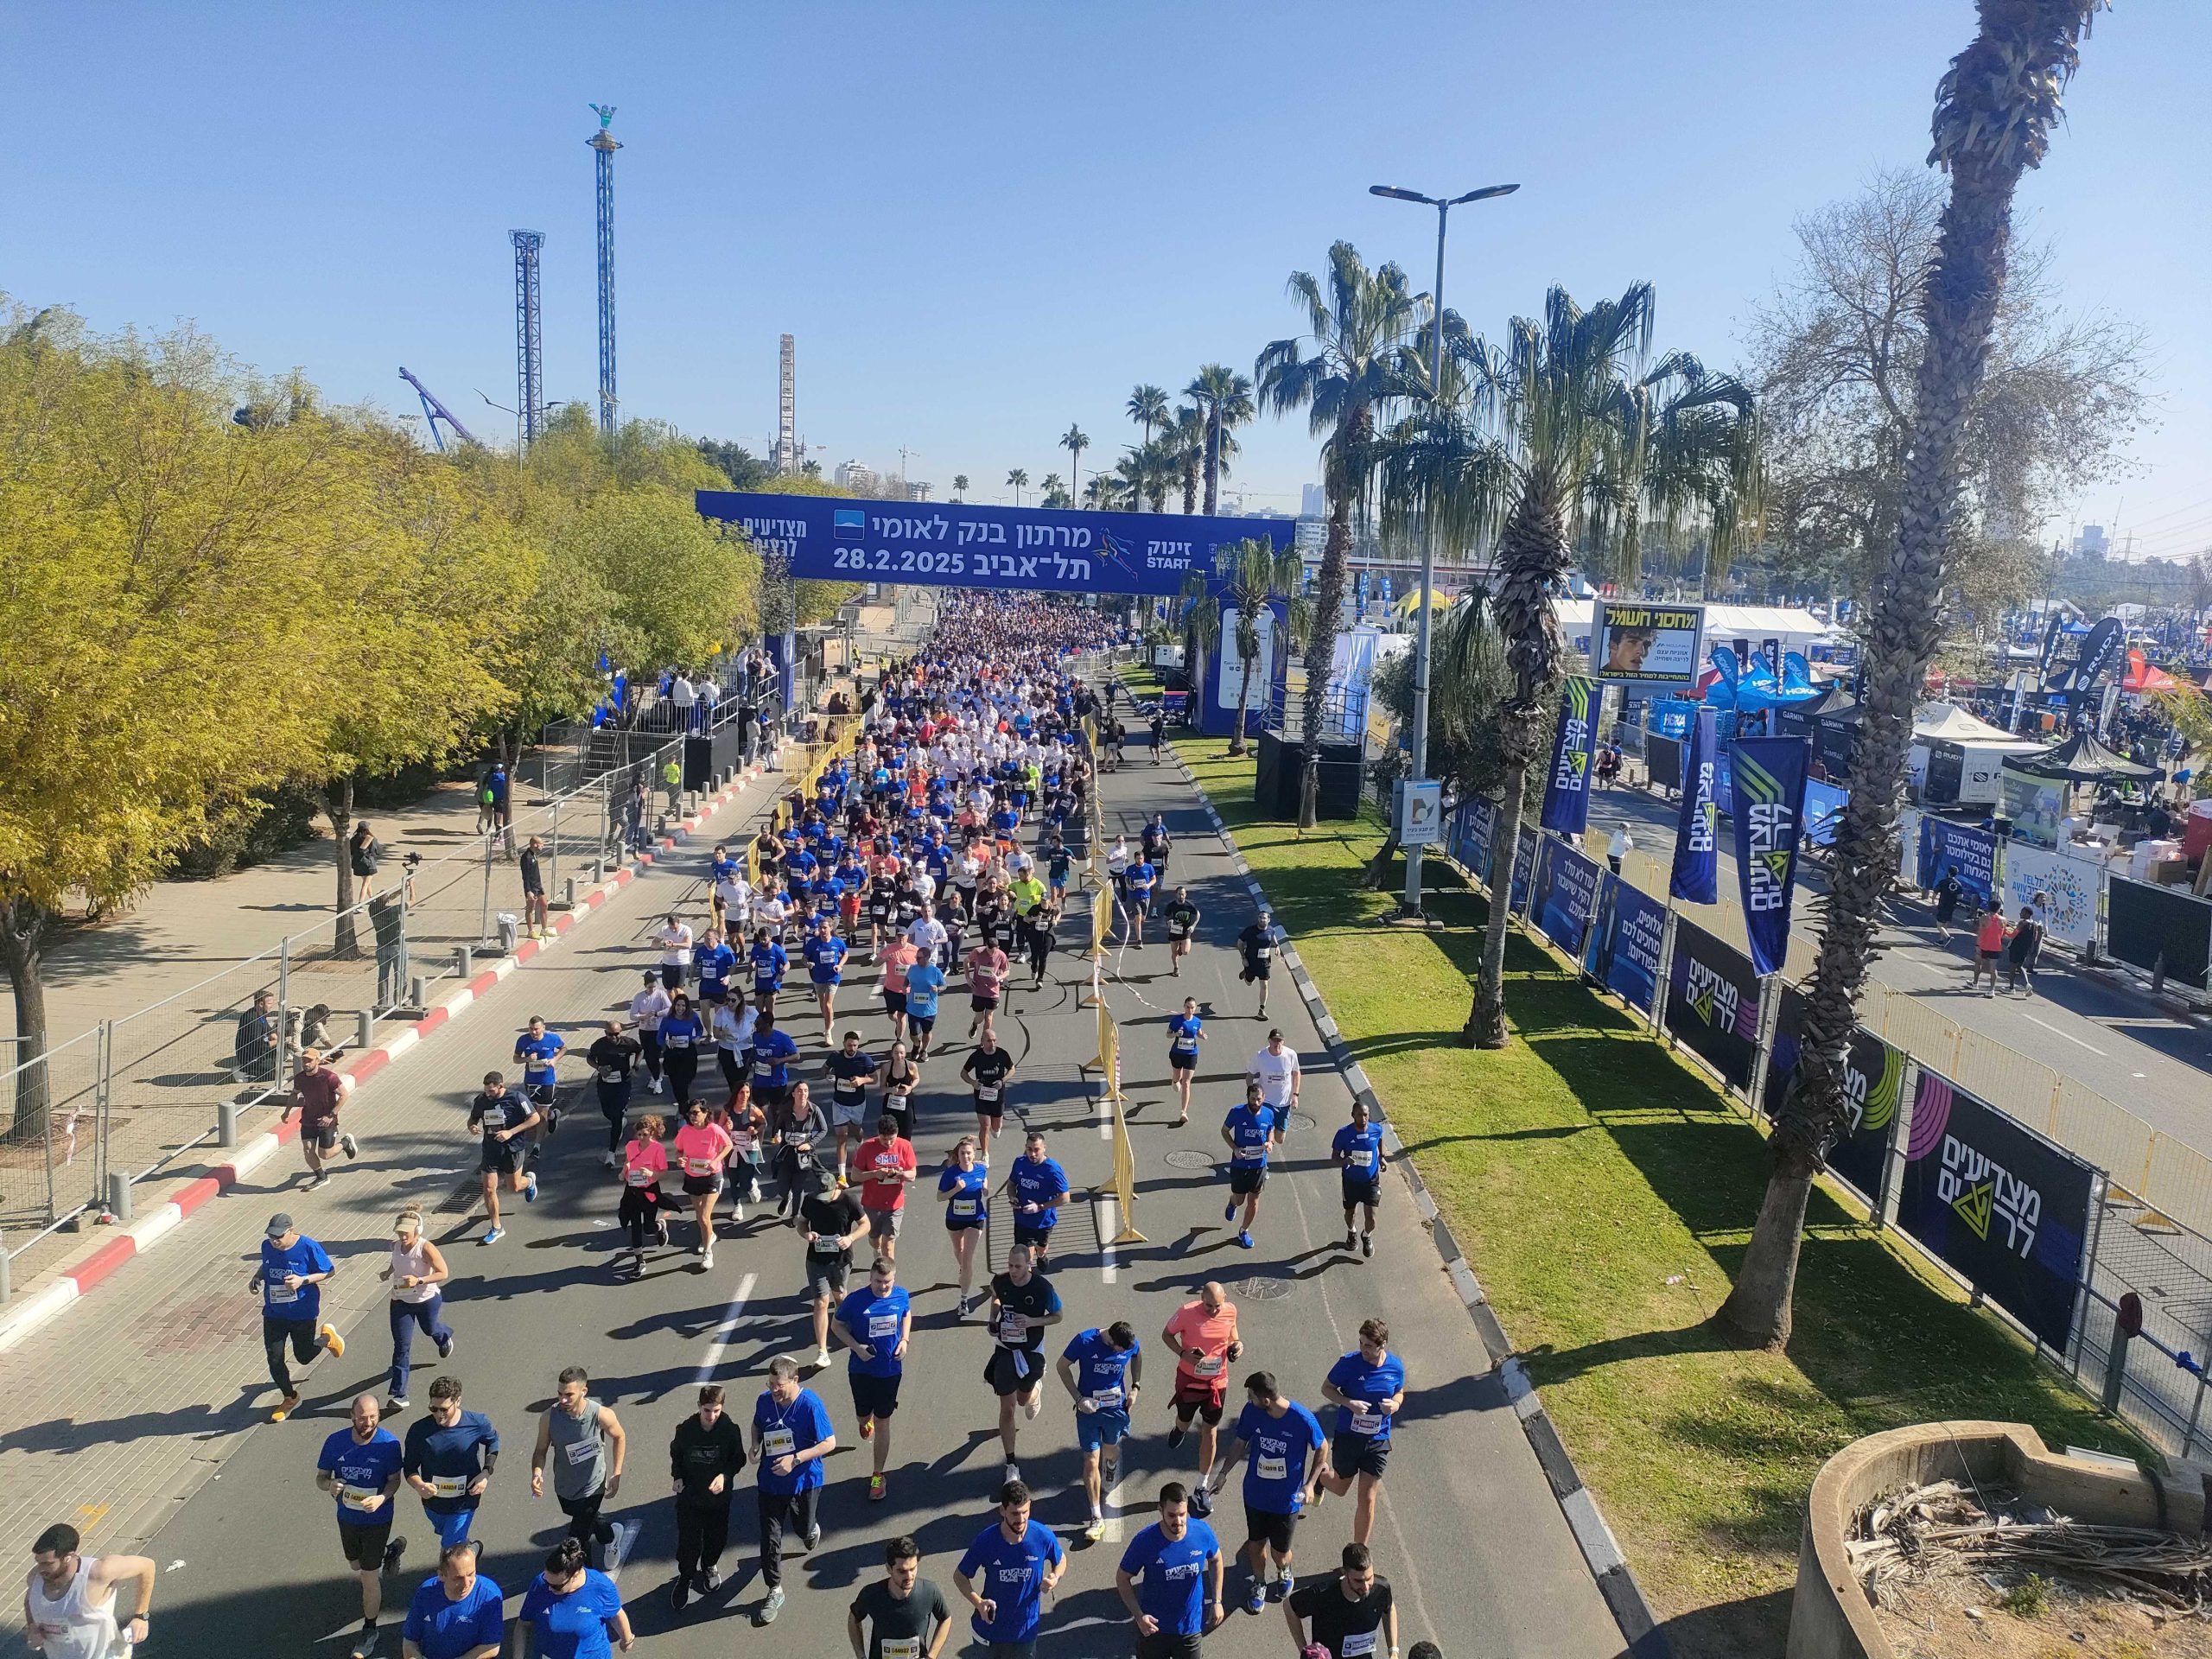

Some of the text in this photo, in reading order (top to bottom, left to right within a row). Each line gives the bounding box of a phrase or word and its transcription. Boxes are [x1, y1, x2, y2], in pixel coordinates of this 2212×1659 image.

[872, 514, 1092, 549] מרתון בנק לאומי
[1147, 540, 1192, 556] זינוק
[834, 547, 964, 574] 28.2.2025
[1147, 556, 1192, 569] START
[1605, 607, 1697, 629] מחסני חשמל
[2087, 625, 2118, 673] RUDY
[1663, 713, 1686, 727] HOKA
[1783, 711, 1804, 722] GARMIN
[1821, 719, 1845, 730] GARMIN
[1555, 718, 1579, 790] מצדיעים
[1942, 752, 1964, 761] RUDY
[1947, 833, 1993, 856] לאומי אתכם
[1749, 804, 1771, 912] מצדיעים
[1945, 844, 1992, 869] גם בקילומטר
[1574, 865, 1584, 880] לא
[2024, 874, 2034, 886] TEL
[2012, 881, 2027, 893] AVIV
[1637, 909, 1663, 937] אלופים,
[1622, 919, 1661, 956] מחכים לכם
[1688, 957, 1738, 1011] מצדיעים
[1942, 1133, 2041, 1227] מצדיעים
